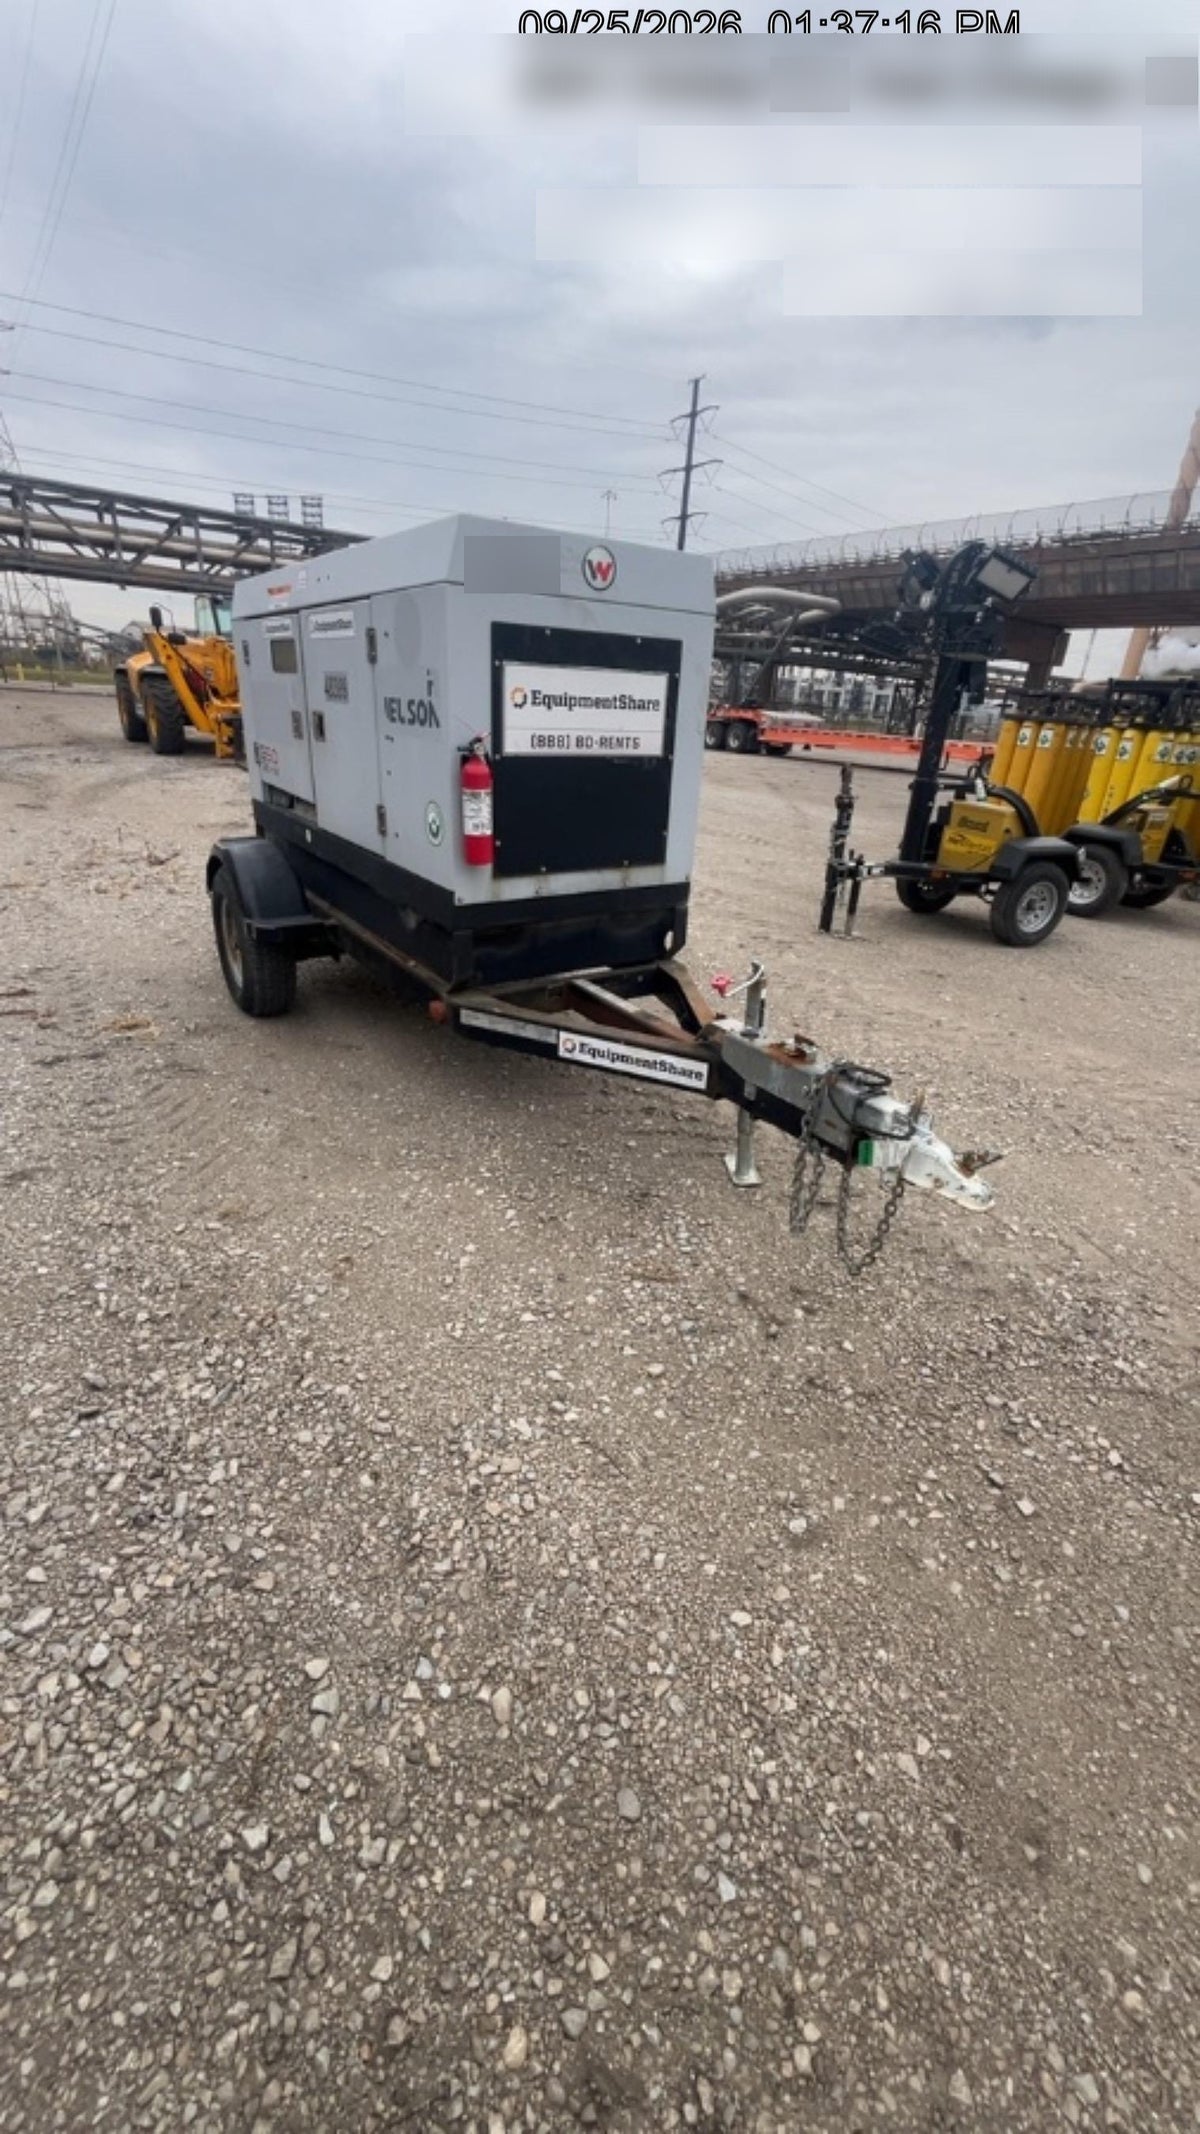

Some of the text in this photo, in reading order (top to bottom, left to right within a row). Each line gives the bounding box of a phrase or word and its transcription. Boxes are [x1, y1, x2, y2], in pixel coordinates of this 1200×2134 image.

[530, 689, 660, 712] EquipmentShare
[575, 735, 641, 750] 80-RENTS
[578, 1042, 705, 1081] EquipmentShare
